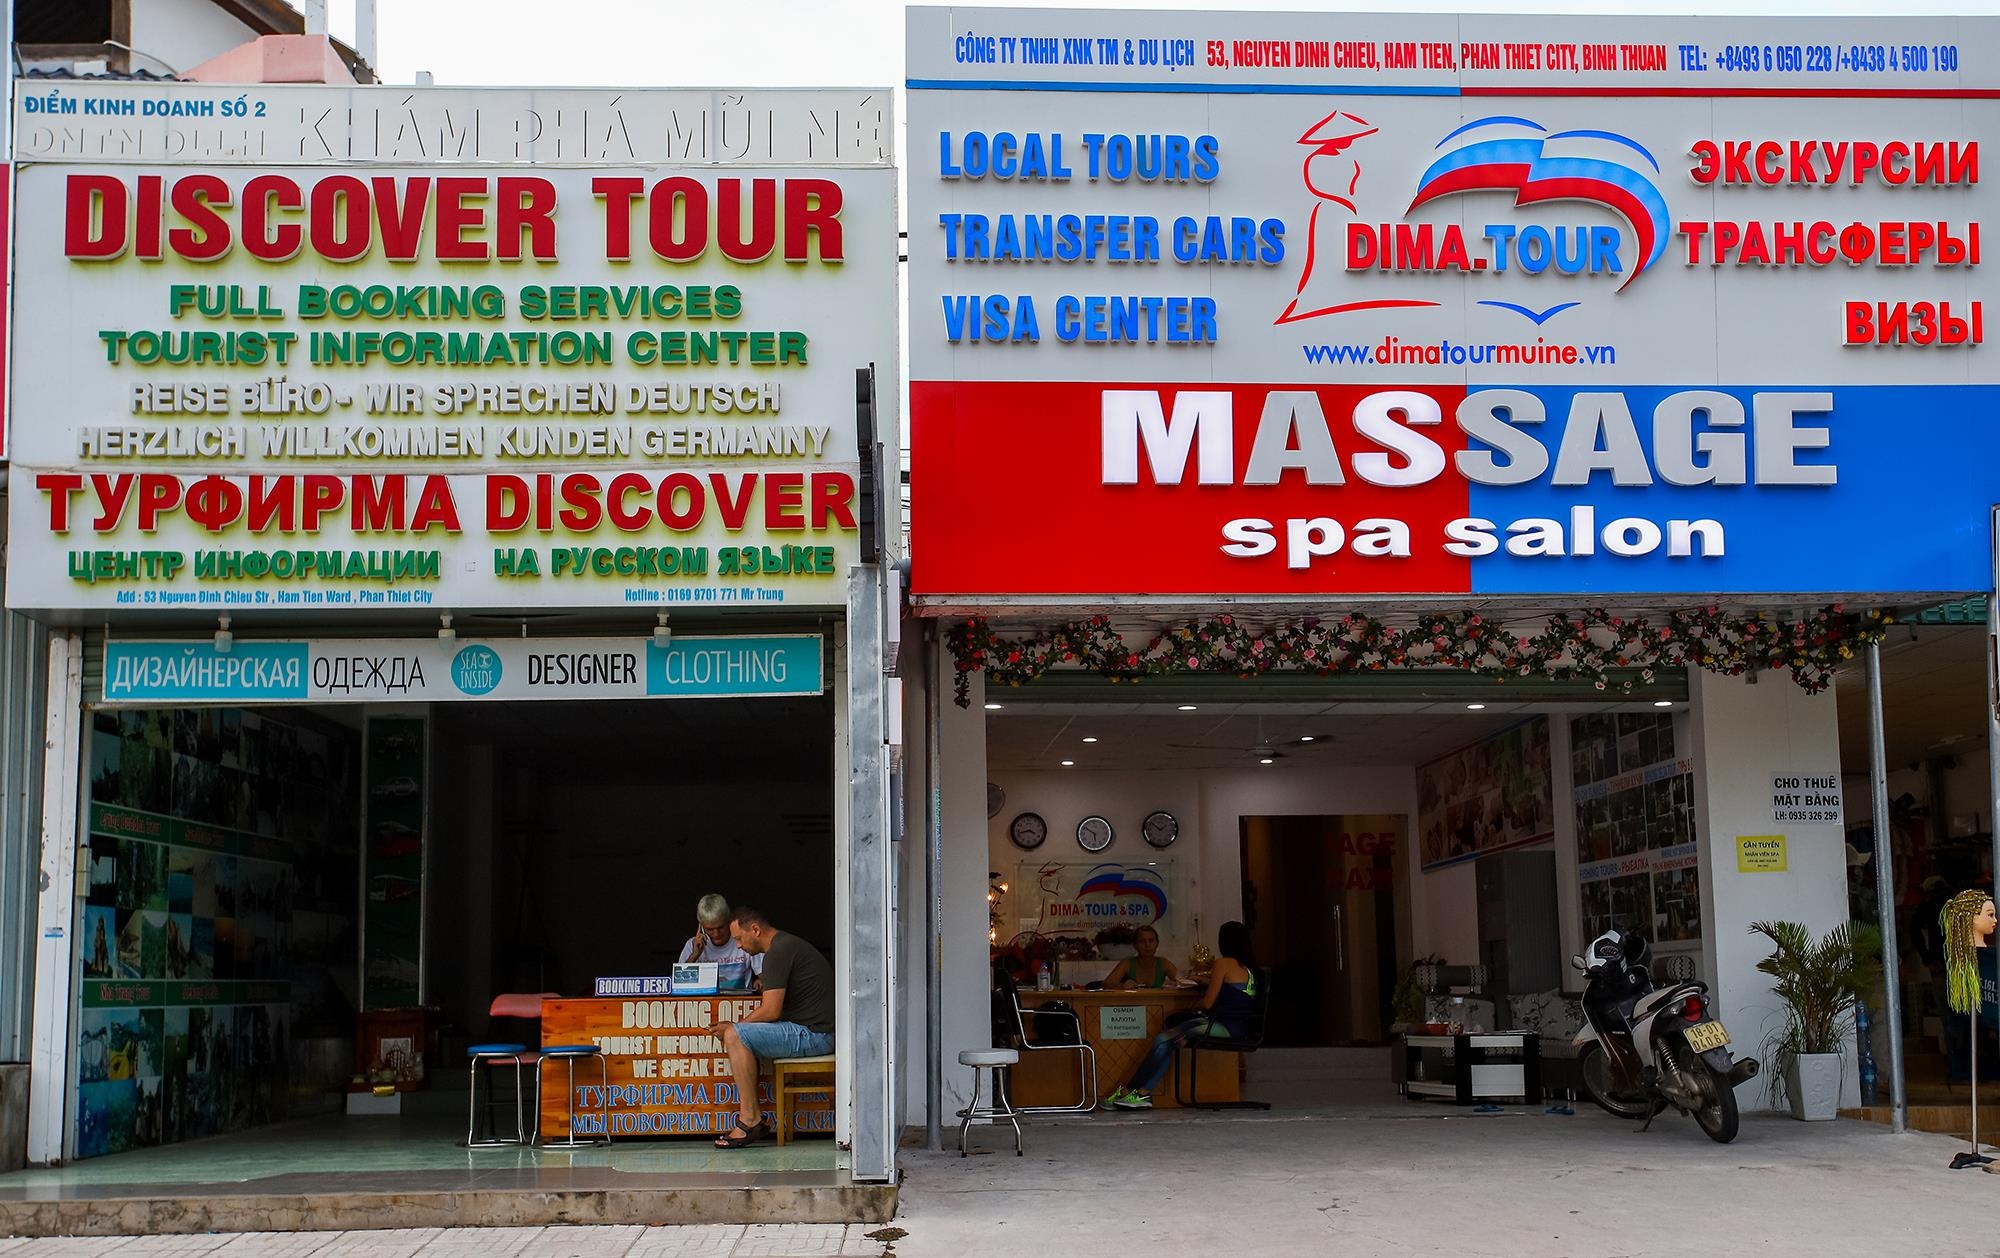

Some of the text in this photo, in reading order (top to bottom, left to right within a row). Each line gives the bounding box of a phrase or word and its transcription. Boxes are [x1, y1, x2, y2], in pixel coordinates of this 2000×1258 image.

[955, 31, 1195, 72] CÔNG TY TNHH XNK TM & DU LỊCH
[1207, 40, 1667, 73] 53, NGUYEN DINH CHIEU, HAM TIEN, PHAN THIET CITY, BINH THUAN
[1678, 44, 1708, 72] TEL:
[1715, 44, 1760, 72] +8493
[1763, 45, 1773, 72] 6
[1776, 45, 1803, 72] 050
[1806, 45, 1831, 72] 228
[1889, 45, 1899, 72] 4
[1901, 45, 1928, 73] 500
[1932, 45, 1958, 72] 190
[25, 89, 266, 118] ĐIỂM KINH DOANH SỐ 2
[299, 94, 480, 158] KHÁM
[514, 95, 635, 158] PHÁ
[940, 131, 1221, 183] LOCAL TOURS
[1687, 139, 1979, 187] ЭКСКУРСИИ
[65, 174, 845, 264] DISCOVER TOUR
[939, 213, 1286, 266] TRANSFER CARS
[1344, 222, 1624, 276] DIMA.TOUR
[1677, 221, 1981, 267] ТРАНСФЕРЫ
[170, 284, 743, 319] FULL BOOKING SERVICES
[940, 294, 1218, 344] VISA CENTER
[1842, 300, 1984, 347] ВИЗЫ
[99, 330, 809, 365] TOURIST INFORMATION CENTER
[1302, 335, 1616, 366] www.dimatourmuine.vn
[129, 382, 229, 415] REISE
[239, 376, 332, 415] BÜRO
[361, 382, 424, 414] WIR
[432, 382, 616, 415] SPRECHEN
[625, 382, 781, 414] DEUTSCH
[76, 425, 831, 458] HERZLICH WILLKOMMEN KUNDEN GERMANNY
[1100, 389, 1838, 487] MASSAGE
[36, 472, 858, 533] ТУРФИРМА DISCOVER
[1219, 504, 1725, 569] spa salon
[68, 545, 836, 583] ЦЕНТР ИНФОРМАЦИИ НА РУССКОМ ЯЗЫКЕ
[116, 591, 135, 603] Add
[144, 591, 156, 603] 53
[159, 591, 196, 604] Nguyen
[255, 591, 269, 603] Str
[278, 590, 299, 602] Ham
[326, 590, 351, 602] Ward
[360, 590, 384, 602] Phan
[414, 590, 432, 604] City
[625, 588, 659, 601] Hotline
[667, 588, 691, 601] 0169
[694, 588, 717, 601] 9701
[720, 587, 737, 601] 771
[741, 587, 754, 601] Mr
[757, 587, 784, 602] Trung
[112, 648, 426, 694] ДИЗАЙНЕРСКАЯ ОДЕЖДА
[460, 651, 477, 670] SEA
[528, 649, 787, 685] DESIGNER CLOTHING
[460, 670, 493, 689] INSIDE
[1774, 775, 1836, 788] CHO THUÊ
[1774, 793, 1800, 808] MẶT
[1775, 811, 1838, 820] LH: 0935 326 299
[1128, 903, 1150, 916] SPA
[598, 977, 669, 994] BOOKING DESK
[622, 1001, 712, 1029] BOOKING
[592, 1036, 653, 1055] TOURIST
[633, 1059, 657, 1078] WE
[661, 1059, 709, 1078] SPEAK
[576, 1083, 710, 1108] ТУРФИРМА
[571, 1113, 607, 1133] МЫ
[611, 1111, 710, 1133] ГОВОРИМ
